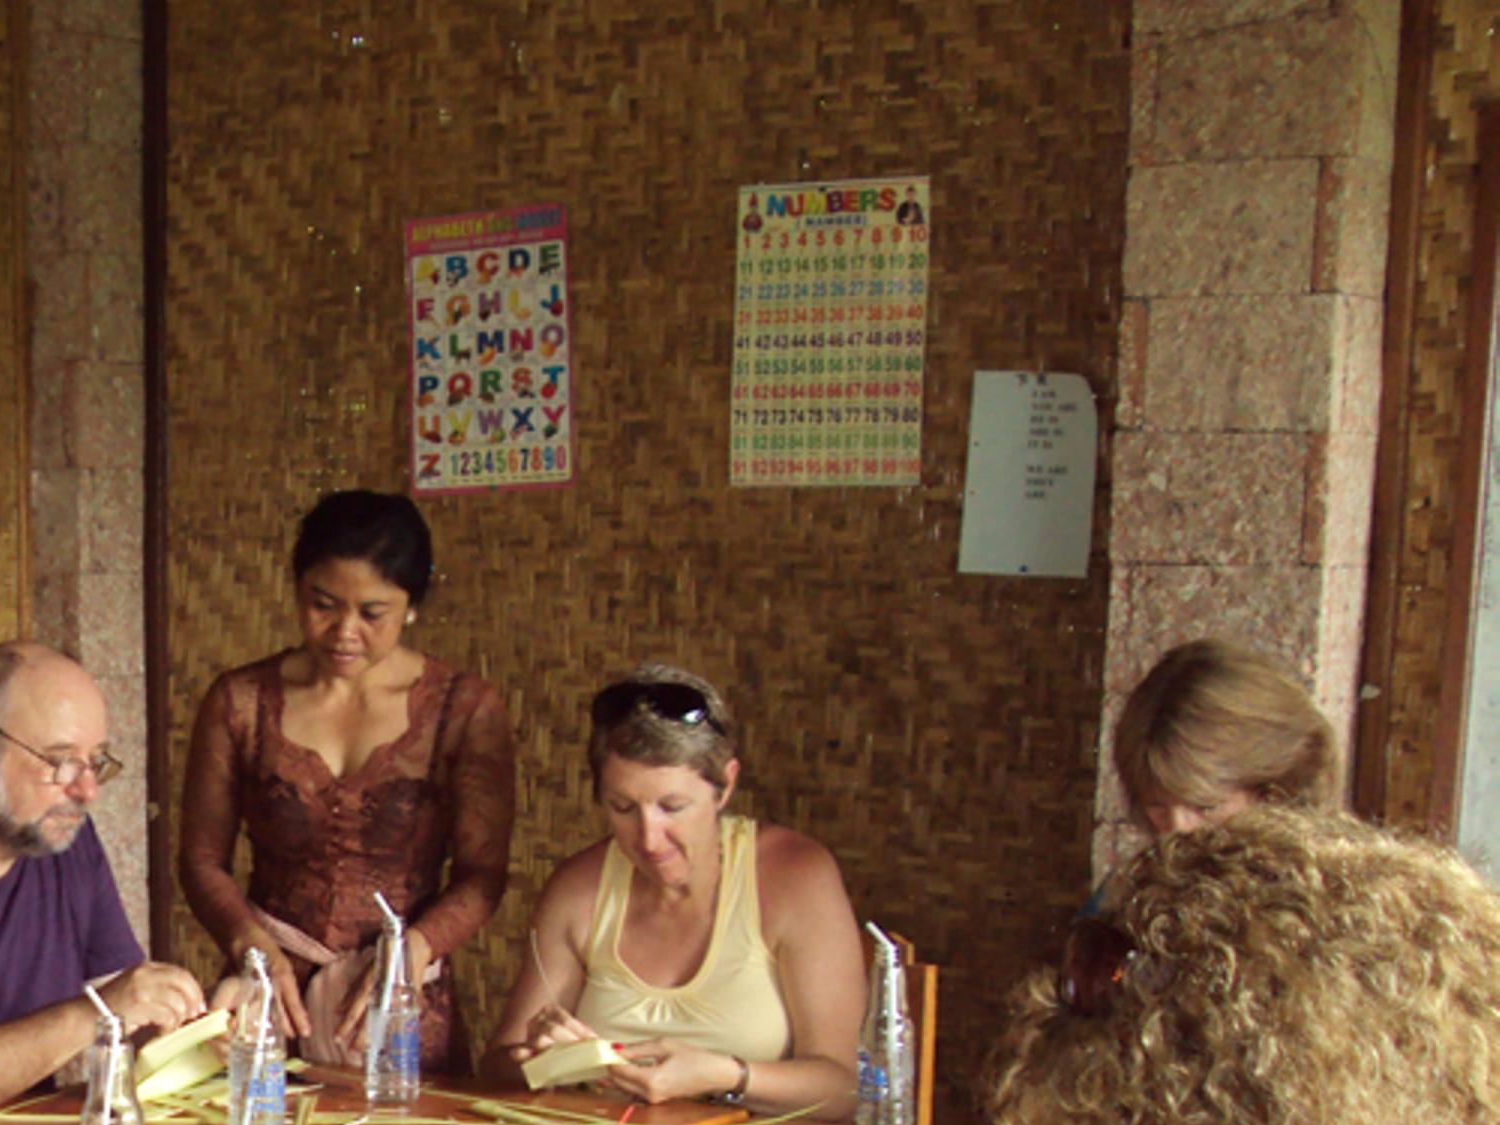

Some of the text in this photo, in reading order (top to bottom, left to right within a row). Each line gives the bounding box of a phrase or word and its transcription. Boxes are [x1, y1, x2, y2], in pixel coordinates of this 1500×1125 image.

[767, 187, 897, 217] NUMBERS
[744, 226, 926, 249] 1 2 3 4 5 6 7 8 9 10
[415, 244, 560, 282] A B C D E
[740, 253, 926, 275] 11 12 13 14 15 16 17 18 19 20
[417, 299, 434, 321] F
[478, 290, 500, 316] H
[541, 284, 560, 309] J
[417, 336, 440, 358] K
[477, 330, 503, 353] M
[510, 327, 532, 351] N
[541, 324, 564, 350] O
[419, 376, 438, 395] P
[480, 371, 502, 393] R
[512, 368, 532, 391] S
[542, 366, 564, 385] T
[419, 405, 564, 437] U V W X Y
[734, 410, 747, 425] 71
[420, 453, 440, 476] Z
